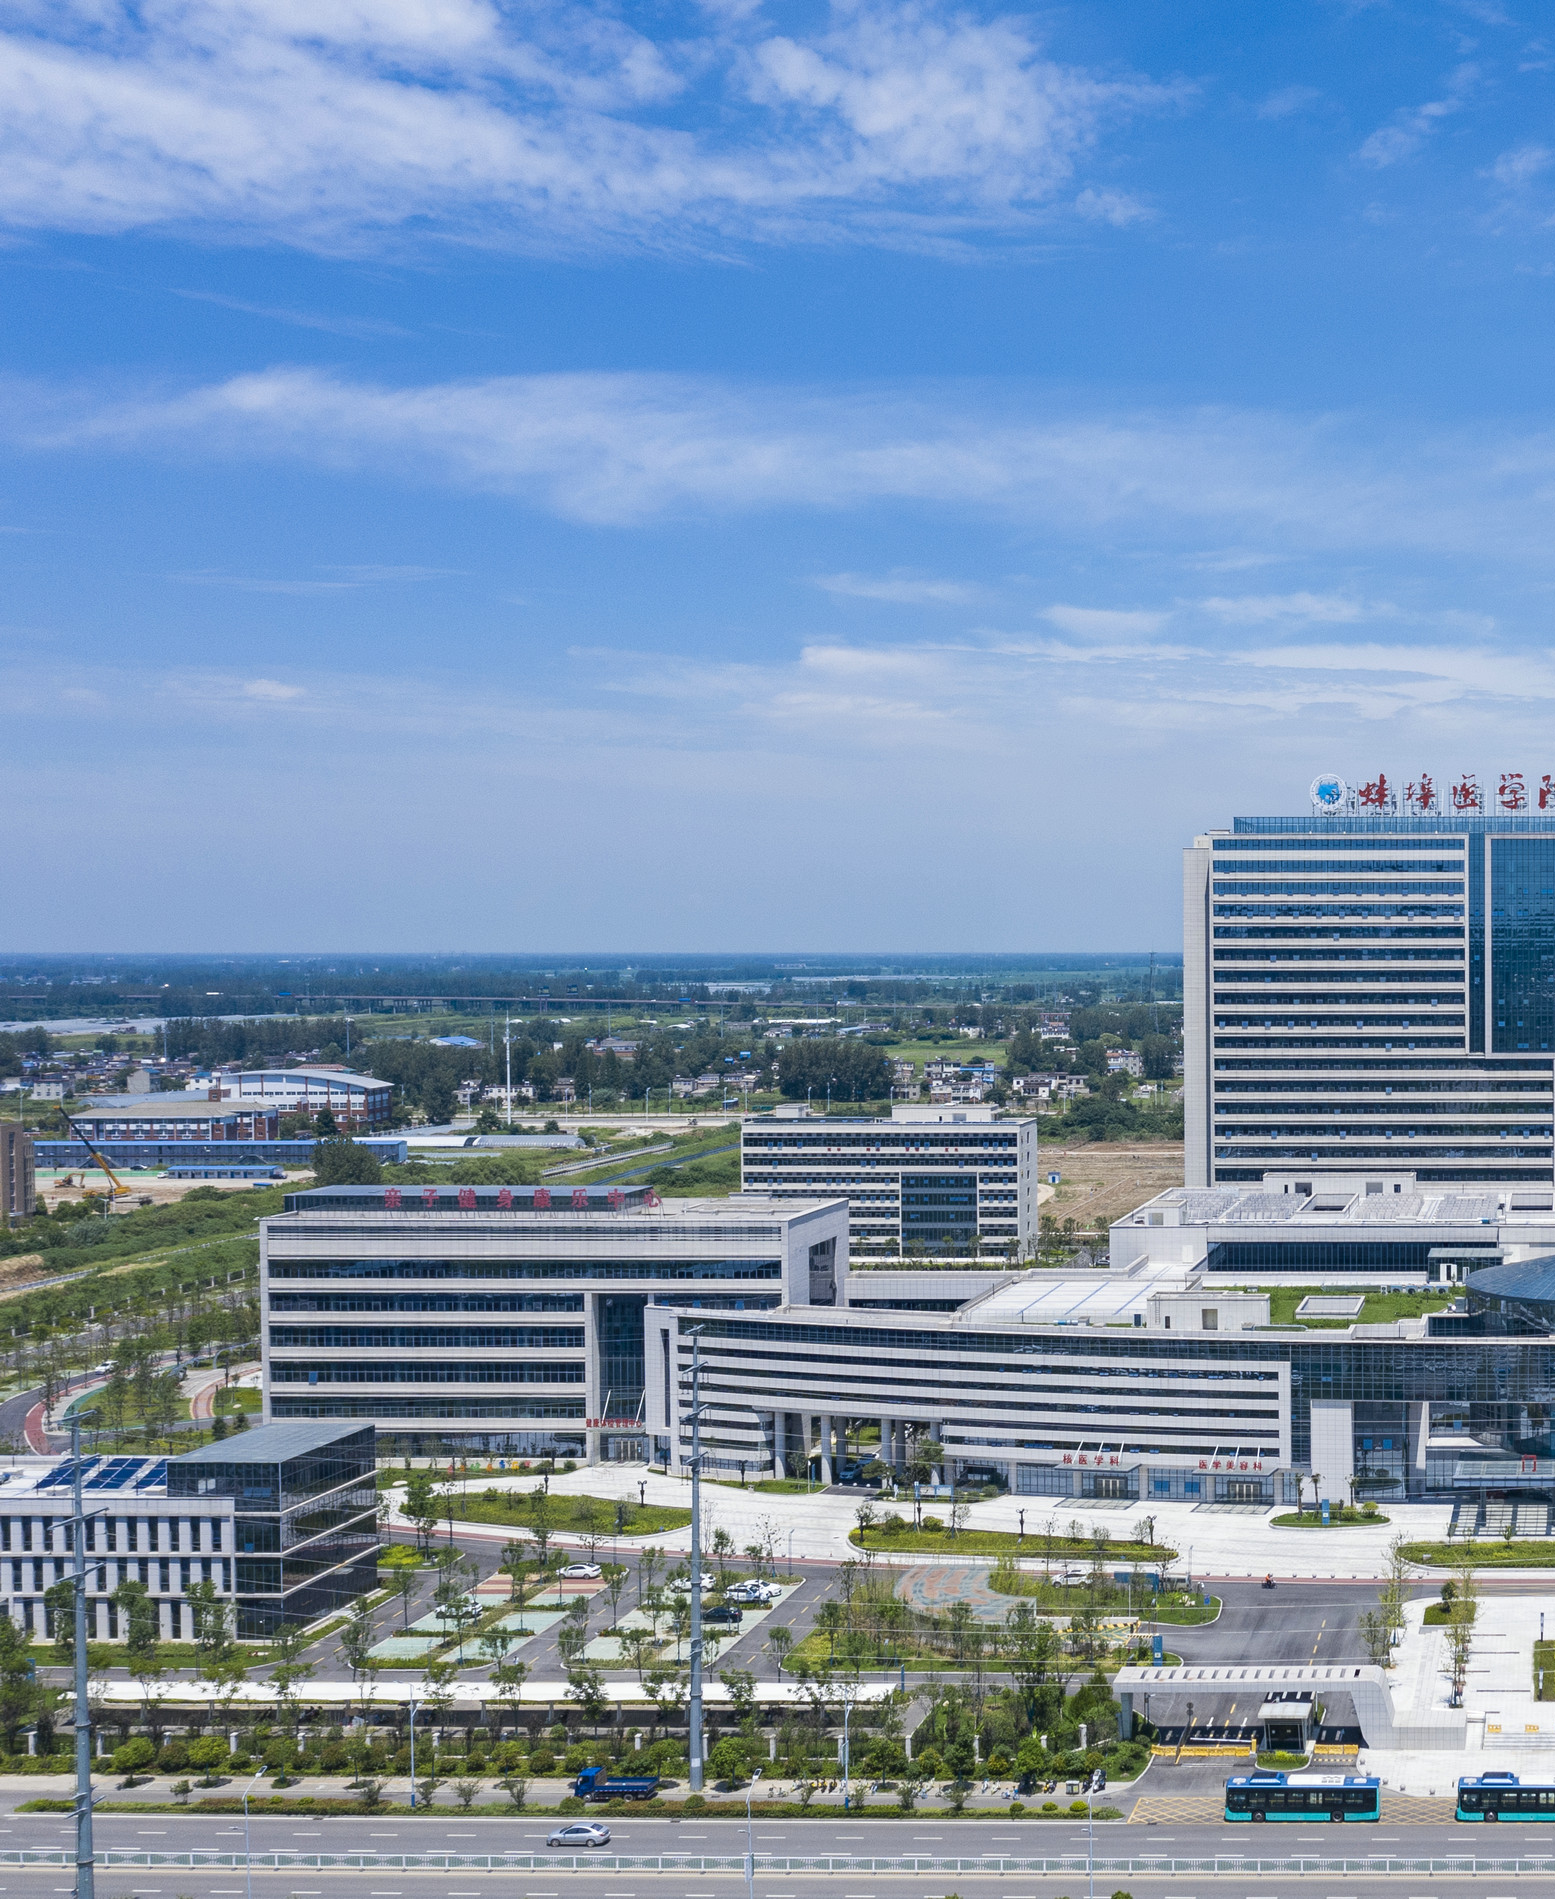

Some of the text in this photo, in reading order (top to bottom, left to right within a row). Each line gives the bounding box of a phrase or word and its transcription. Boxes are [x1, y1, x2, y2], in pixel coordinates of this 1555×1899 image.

[384, 1188, 663, 1209] 亲子健身康乐中心
[1062, 1453, 1120, 1467] 核医学科
[1199, 1459, 1263, 1472] 医学美容科
